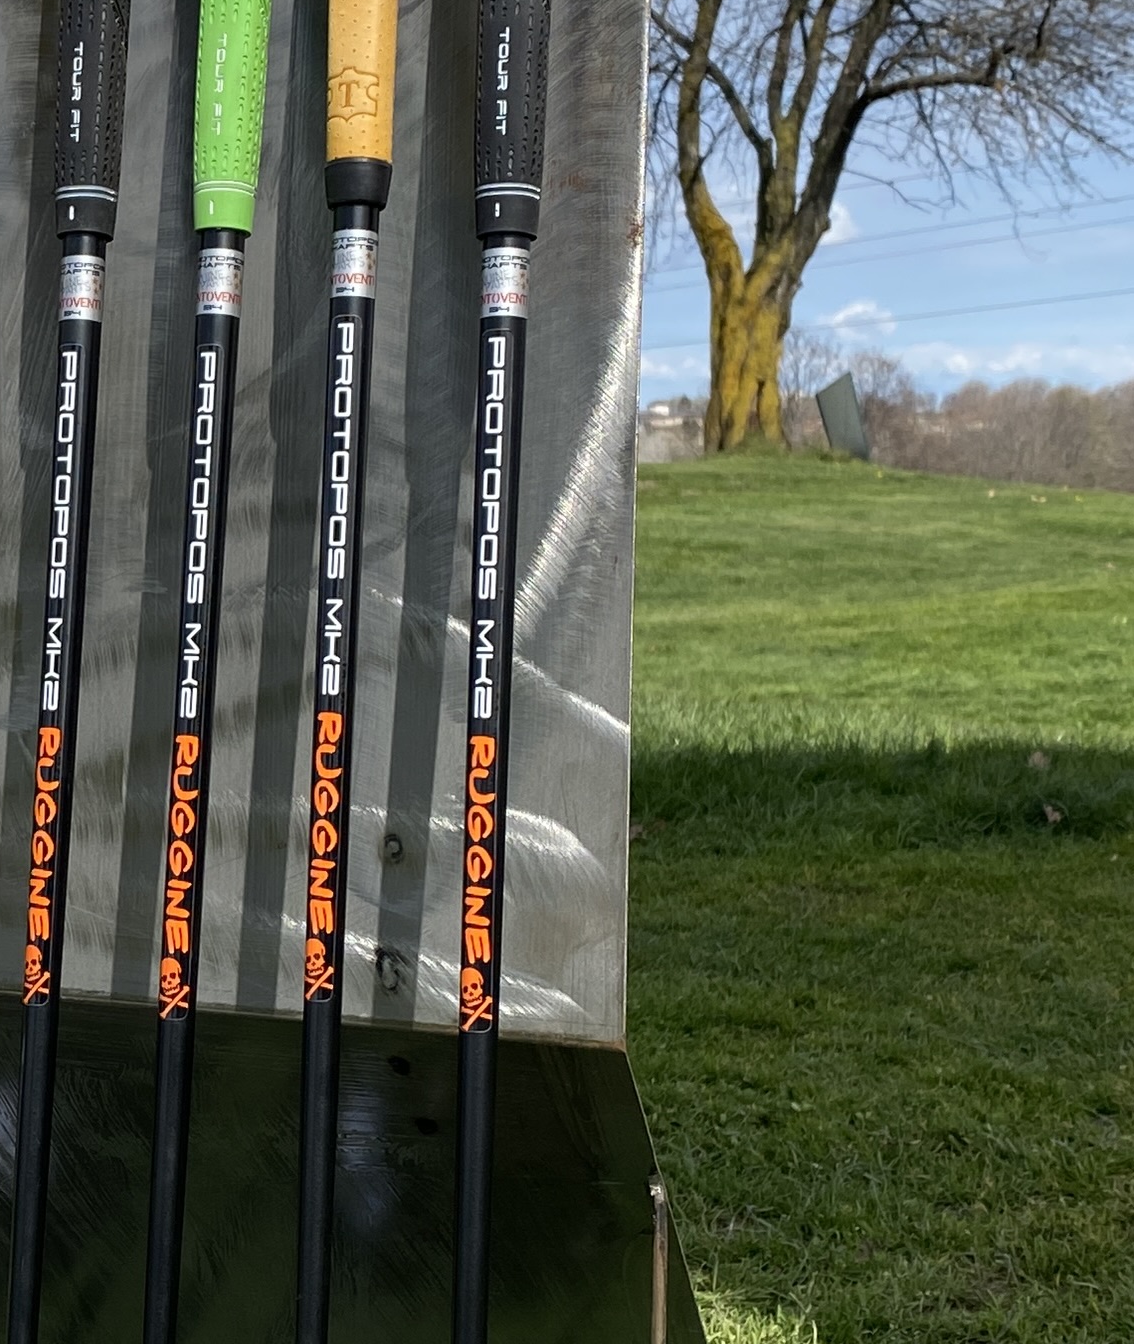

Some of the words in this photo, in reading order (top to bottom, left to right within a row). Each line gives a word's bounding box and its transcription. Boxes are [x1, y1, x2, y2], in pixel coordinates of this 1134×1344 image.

[70, 41, 84, 101] TOUR
[213, 32, 228, 94] TOUR
[497, 26, 510, 91] TOUR
[69, 108, 81, 143] FIT
[211, 102, 223, 136] FIT
[495, 99, 507, 136] FIT
[49, 350, 77, 599] PROTOPOS
[187, 352, 216, 606] PROTOPOS
[326, 321, 354, 581] PROTOPOS
[478, 336, 506, 600] PROTOPOS
[40, 617, 62, 711] MK2
[179, 623, 201, 719] MK2
[318, 599, 341, 695] MK2
[471, 620, 495, 719] MK2
[28, 726, 61, 942] RUGGINE
[166, 734, 199, 955] RUGGINE
[306, 712, 343, 936] RUGGINE
[461, 735, 497, 965] RUGGINE
